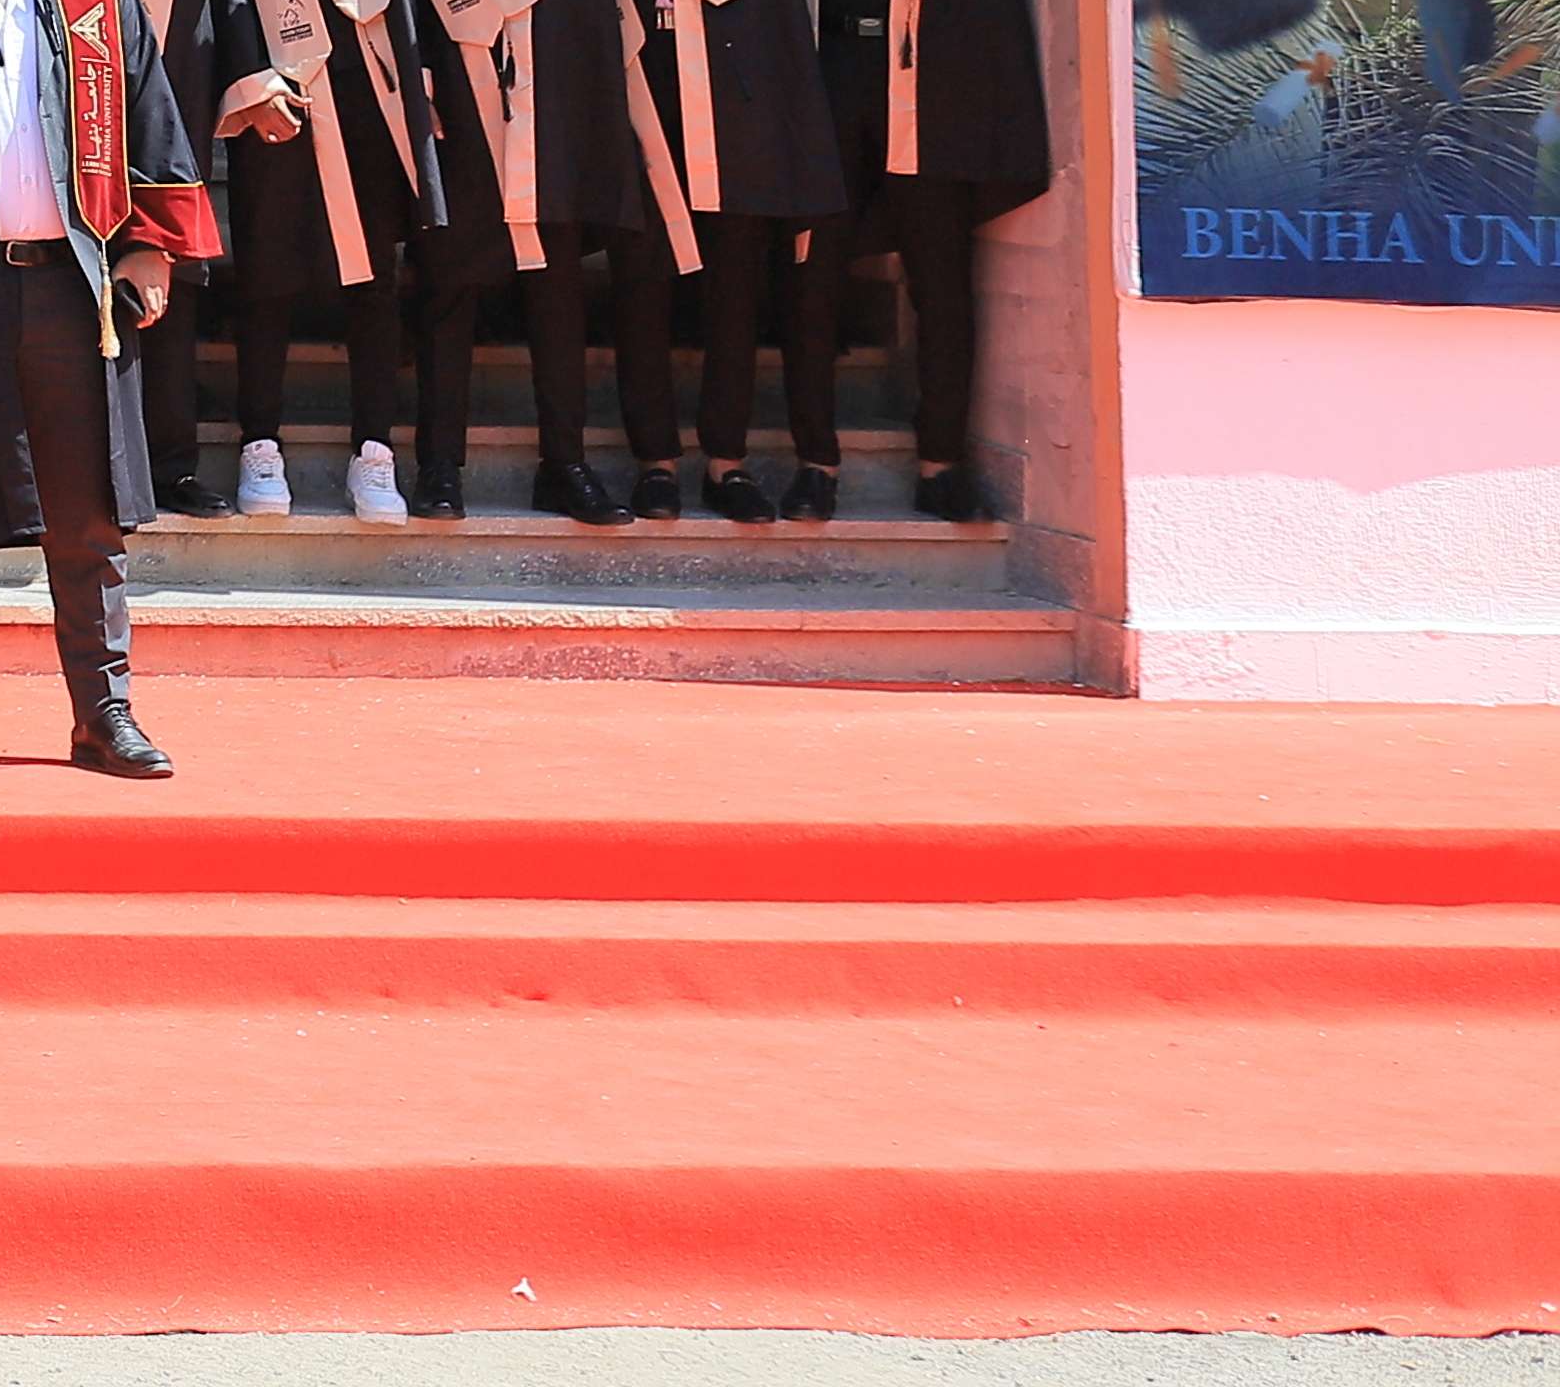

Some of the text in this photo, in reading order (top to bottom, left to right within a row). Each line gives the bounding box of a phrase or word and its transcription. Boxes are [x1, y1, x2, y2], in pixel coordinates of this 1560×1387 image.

[103, 65, 113, 162] BENHA UNIVERSITY
[1179, 206, 1425, 264] BENHA
